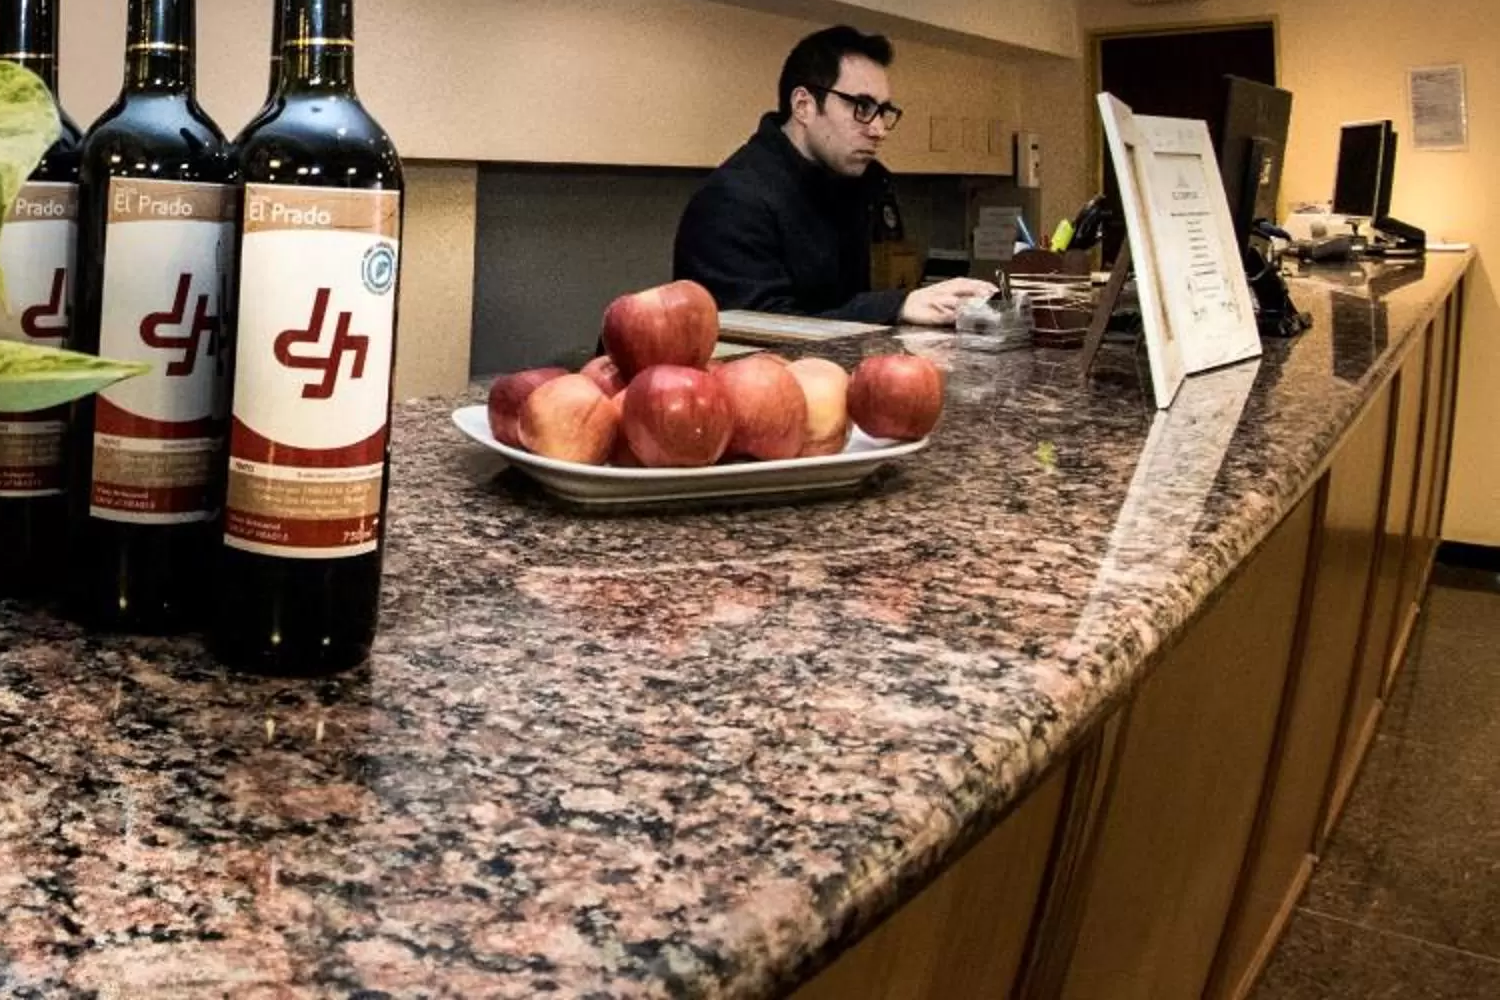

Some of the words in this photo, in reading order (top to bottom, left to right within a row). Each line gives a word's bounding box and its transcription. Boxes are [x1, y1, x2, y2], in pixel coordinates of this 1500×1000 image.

[15, 197, 65, 216] Prado
[114, 188, 131, 213] El
[139, 194, 193, 216] Prado
[250, 196, 265, 222] El
[271, 202, 331, 225] Prado
